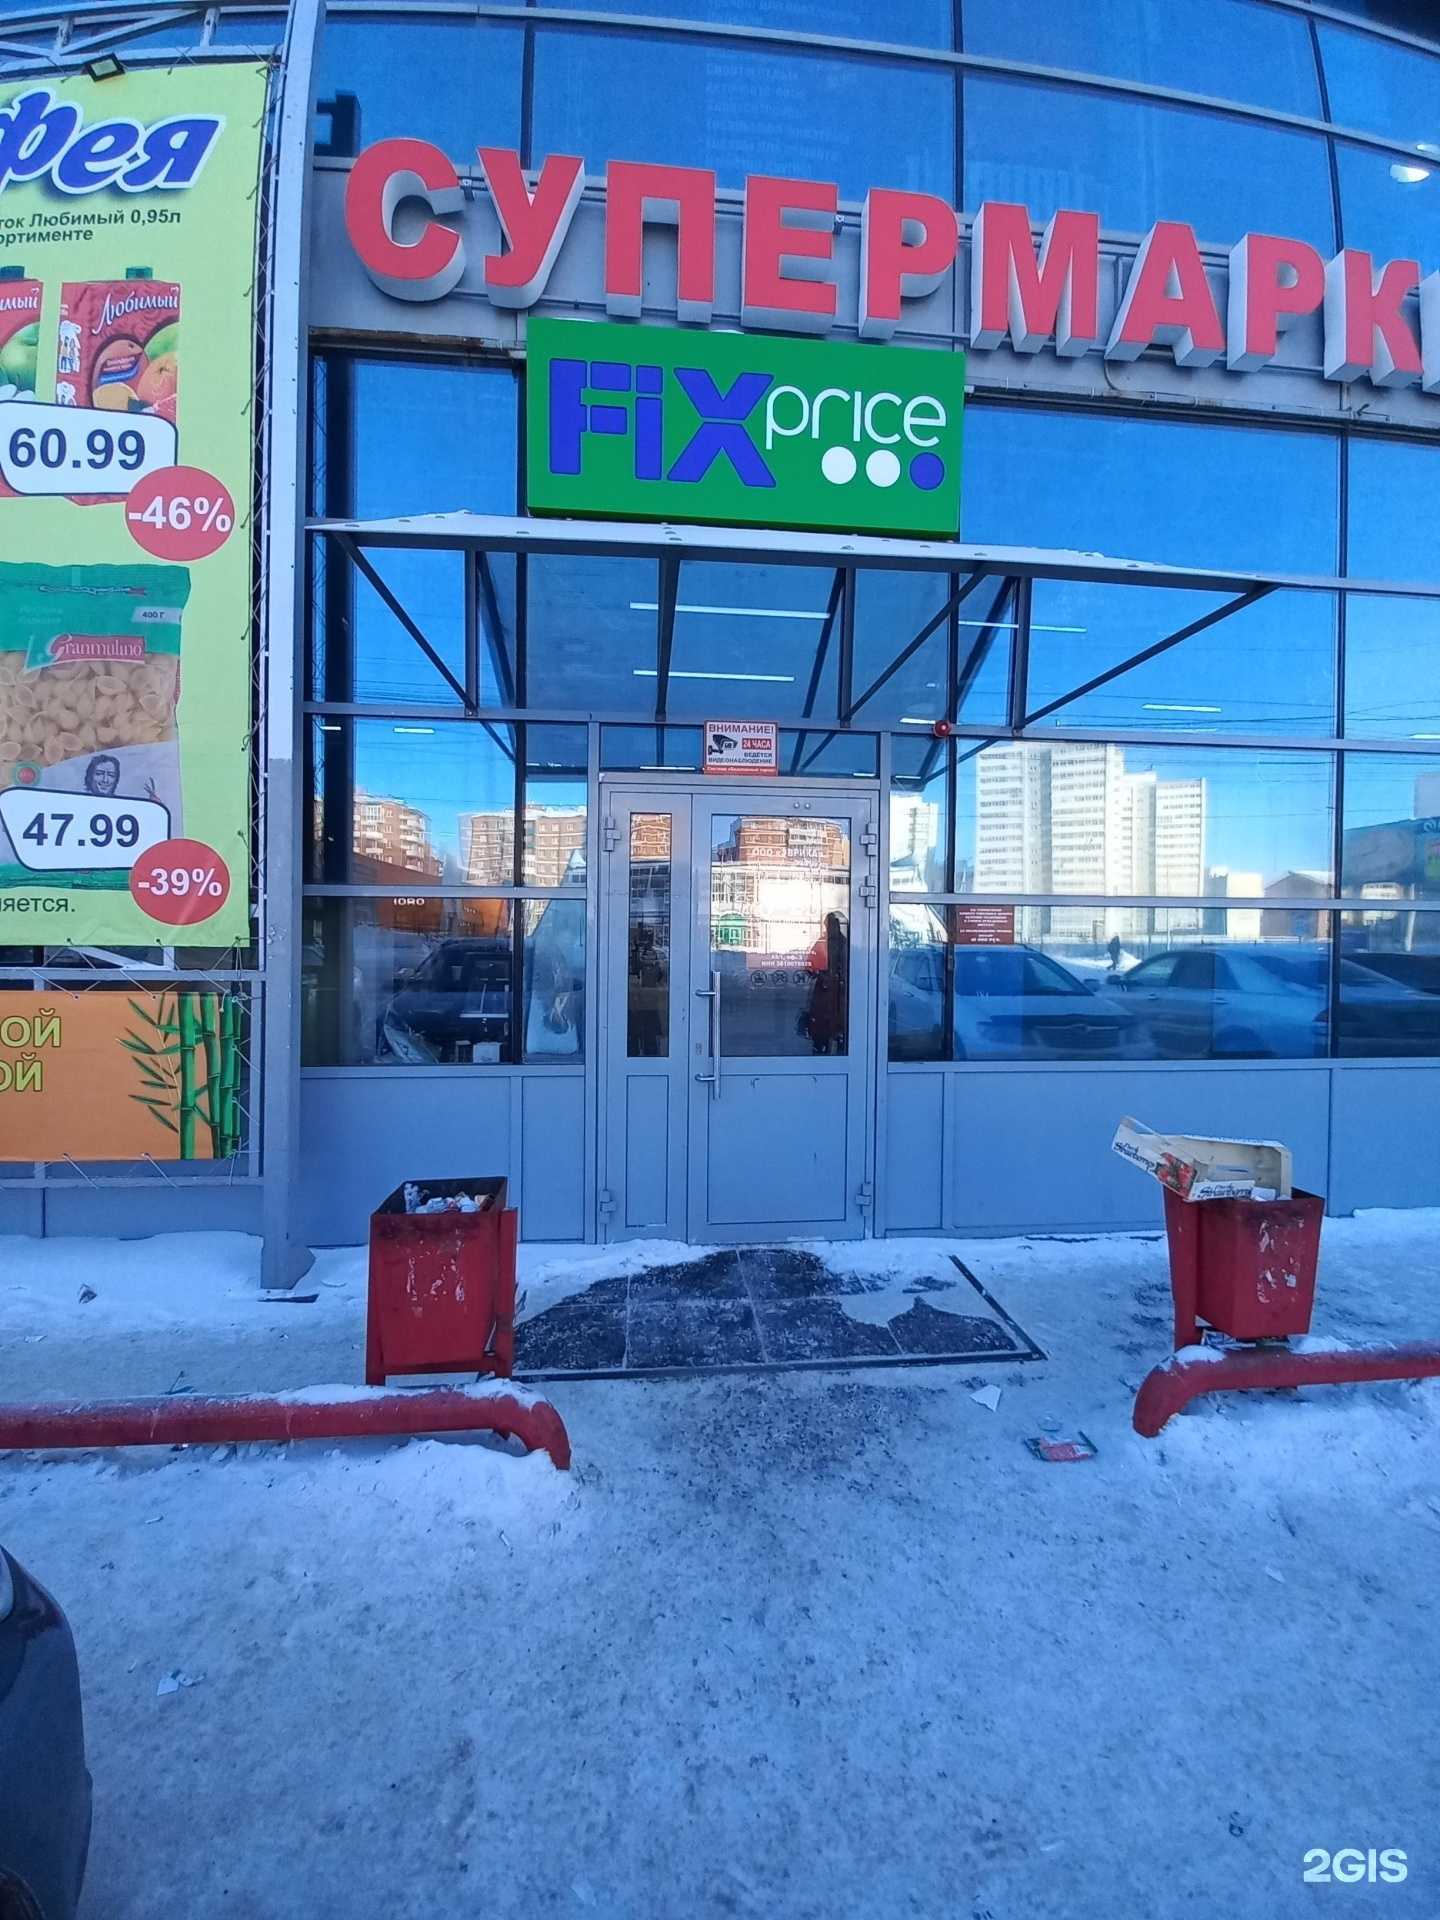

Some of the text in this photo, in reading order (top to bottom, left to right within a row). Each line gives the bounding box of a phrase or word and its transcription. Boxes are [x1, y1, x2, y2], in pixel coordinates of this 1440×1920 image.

[29, 211, 125, 227] Любимый
[130, 209, 181, 226] 0,95л
[345, 137, 1440, 392] СУПЕРМАРК
[92, 287, 180, 334] Любимый
[9, 427, 146, 470] 60.99
[128, 495, 232, 532] -46%
[47, 633, 143, 662] Granmulino
[708, 724, 774, 734] ВНИМАНИЕ!
[752, 740, 771, 749] ЧАСА
[22, 812, 140, 848] 47.99
[138, 868, 223, 896] -39%
[0, 897, 75, 912] яется.
